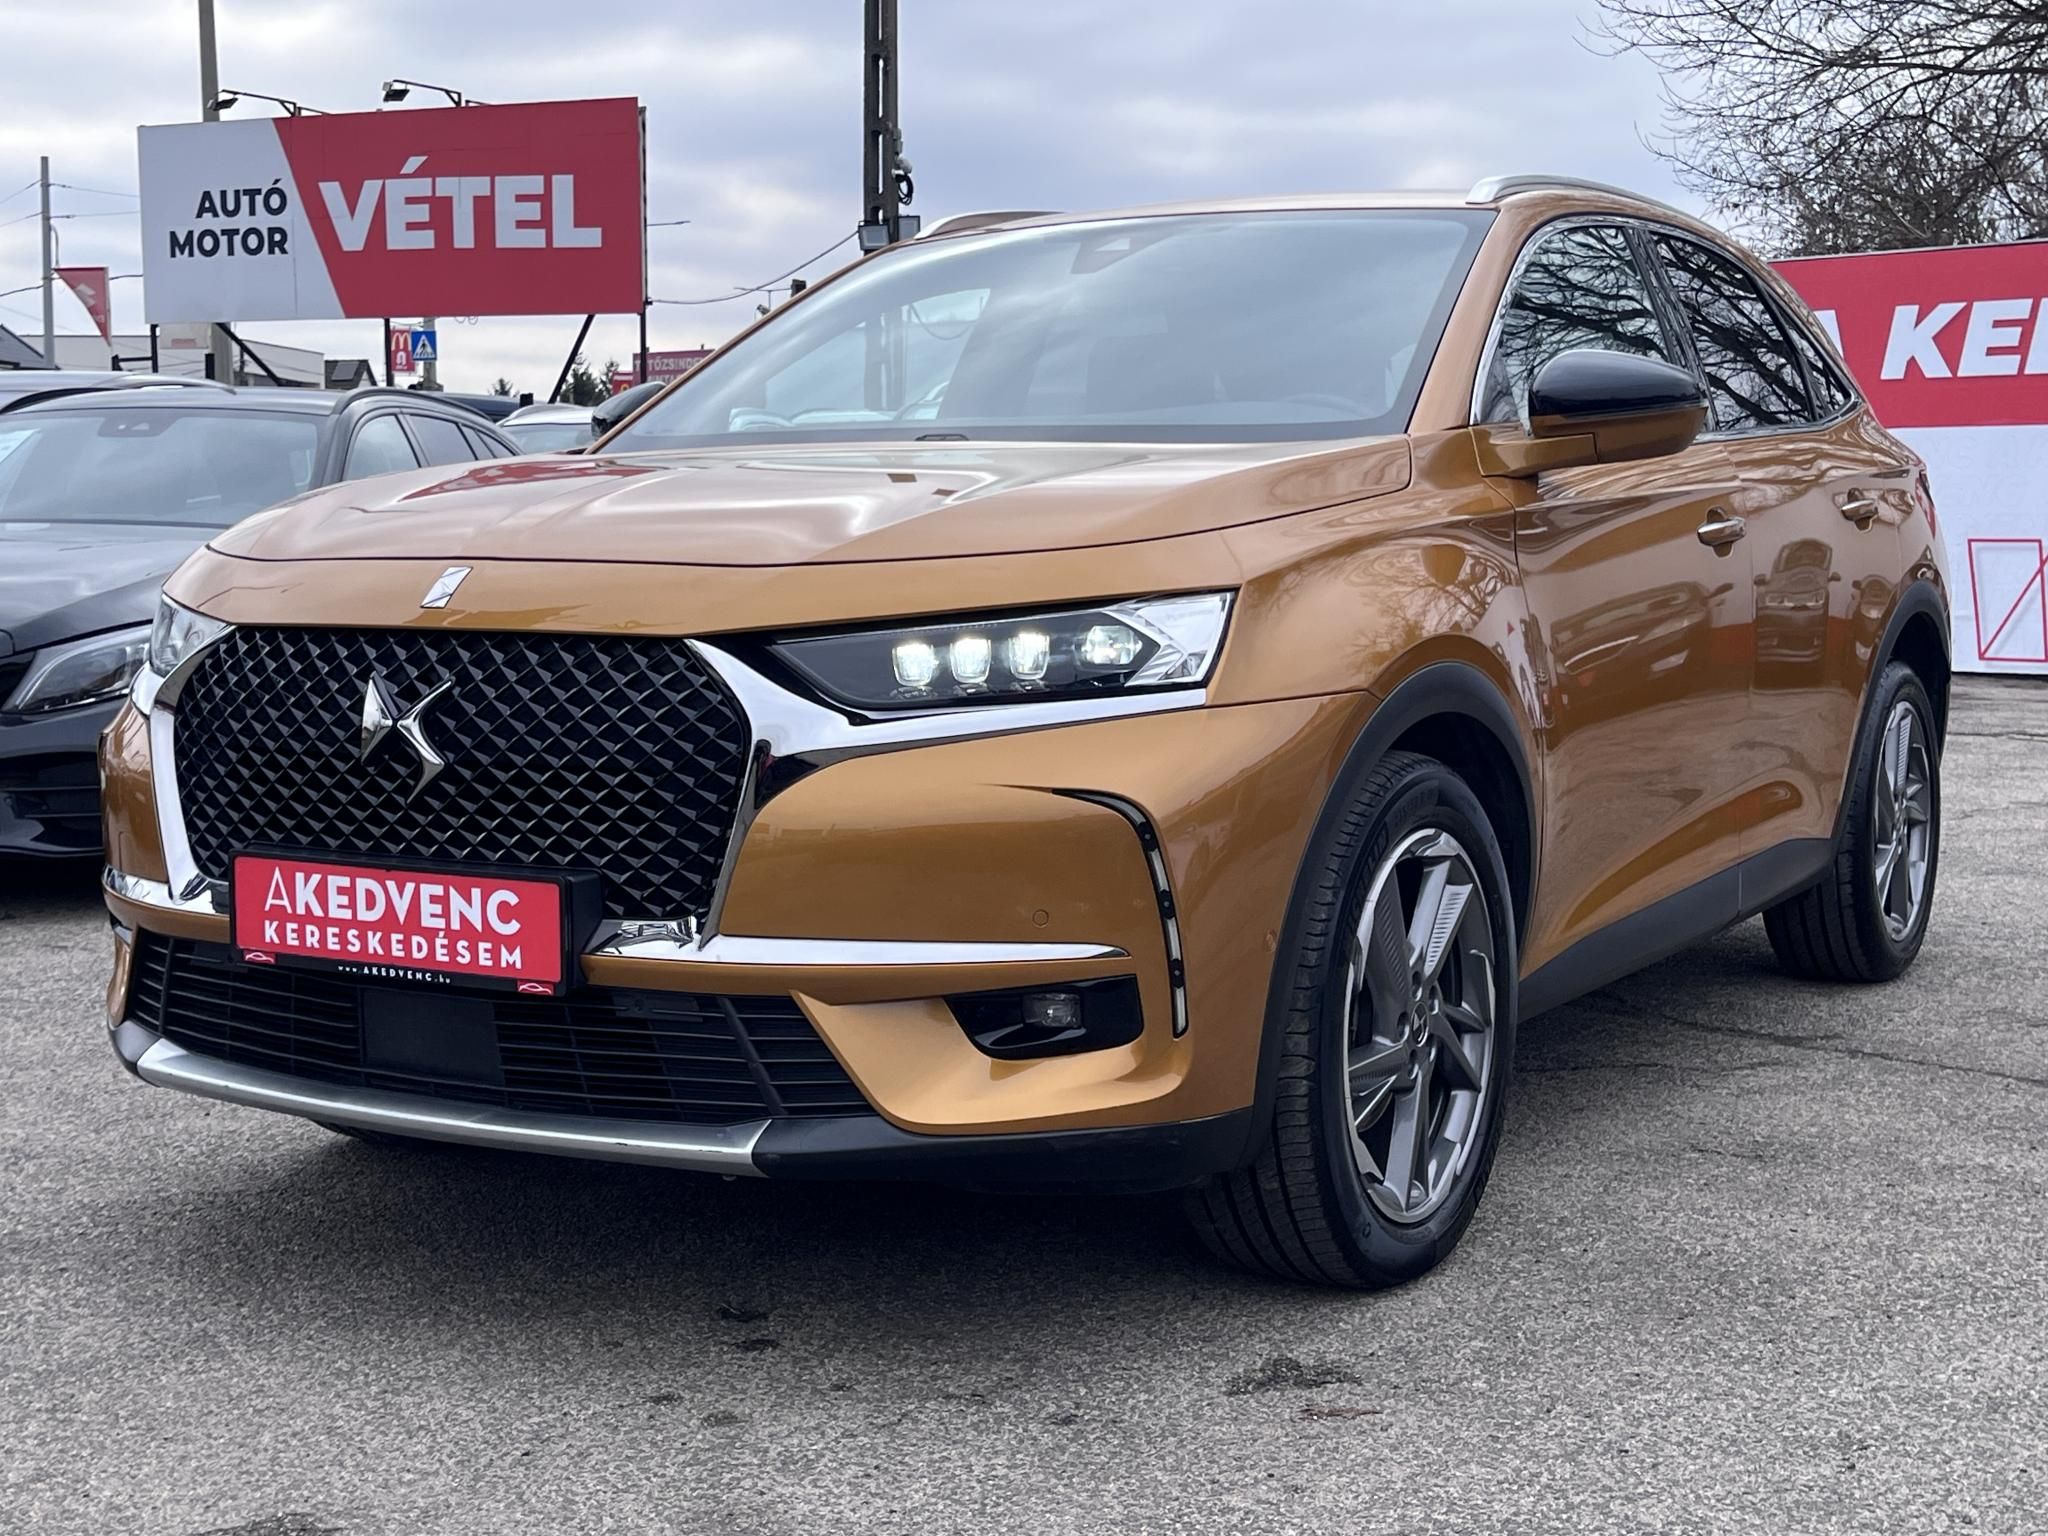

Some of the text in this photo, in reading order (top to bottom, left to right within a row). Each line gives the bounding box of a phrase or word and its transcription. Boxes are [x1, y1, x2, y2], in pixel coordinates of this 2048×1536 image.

[195, 178, 288, 219] AUTÓ
[318, 155, 603, 252] VÉTEL
[169, 227, 289, 258] MOTOR
[264, 919, 523, 970] KERESKEDÉSEM
